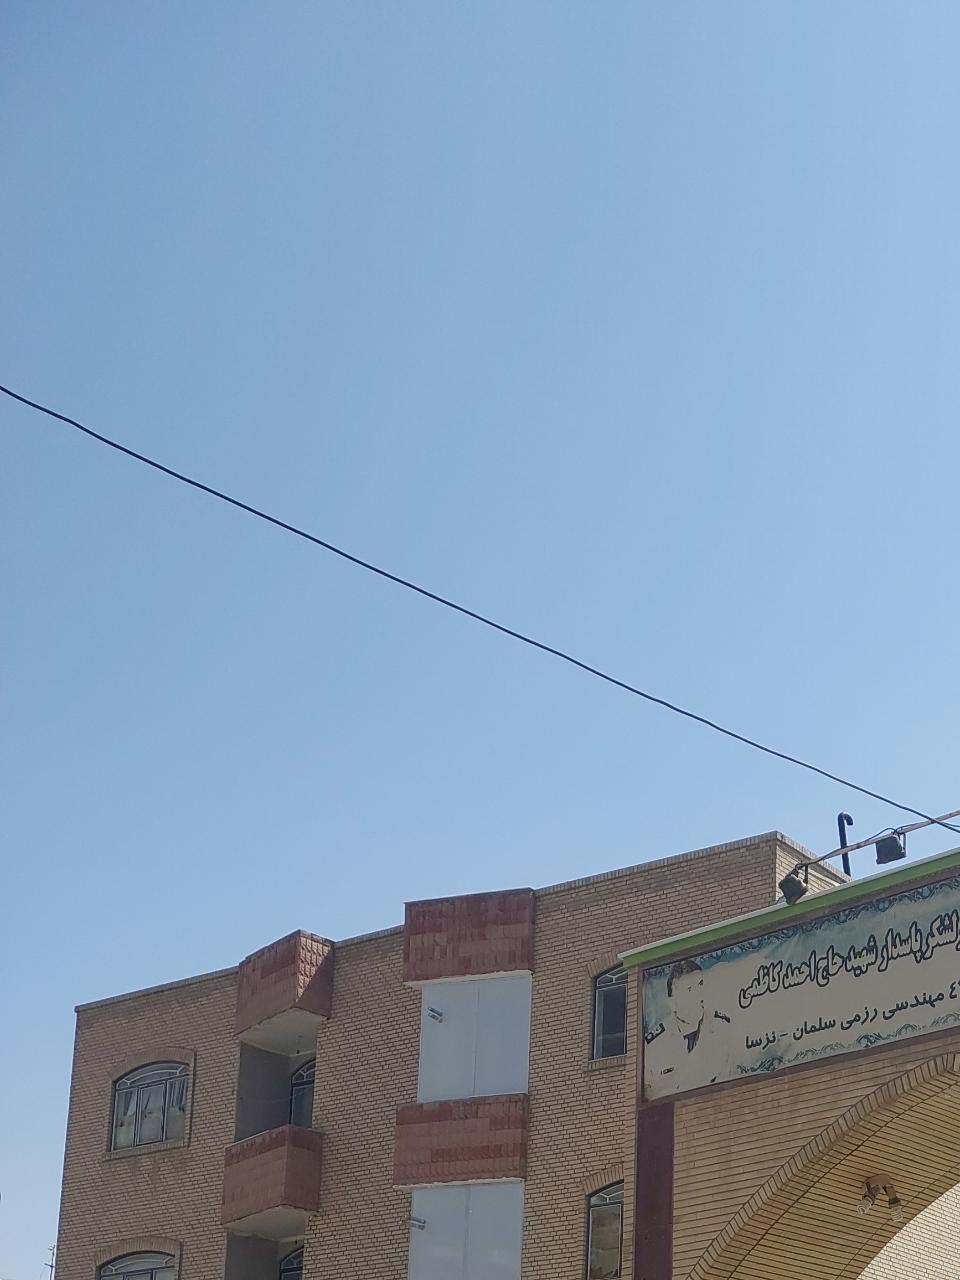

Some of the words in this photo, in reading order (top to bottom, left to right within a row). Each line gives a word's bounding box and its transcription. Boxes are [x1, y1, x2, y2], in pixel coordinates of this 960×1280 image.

[816, 945, 845, 987] حاج
[844, 934, 879, 977] شهید
[878, 920, 923, 972] پاسدار
[738, 959, 784, 1009] کاظمی
[782, 949, 817, 990] احمد
[841, 1006, 878, 1032] رزمی
[882, 989, 945, 1021] مهندسی
[745, 1031, 777, 1050] نزسا
[792, 1017, 836, 1041] سلمان
